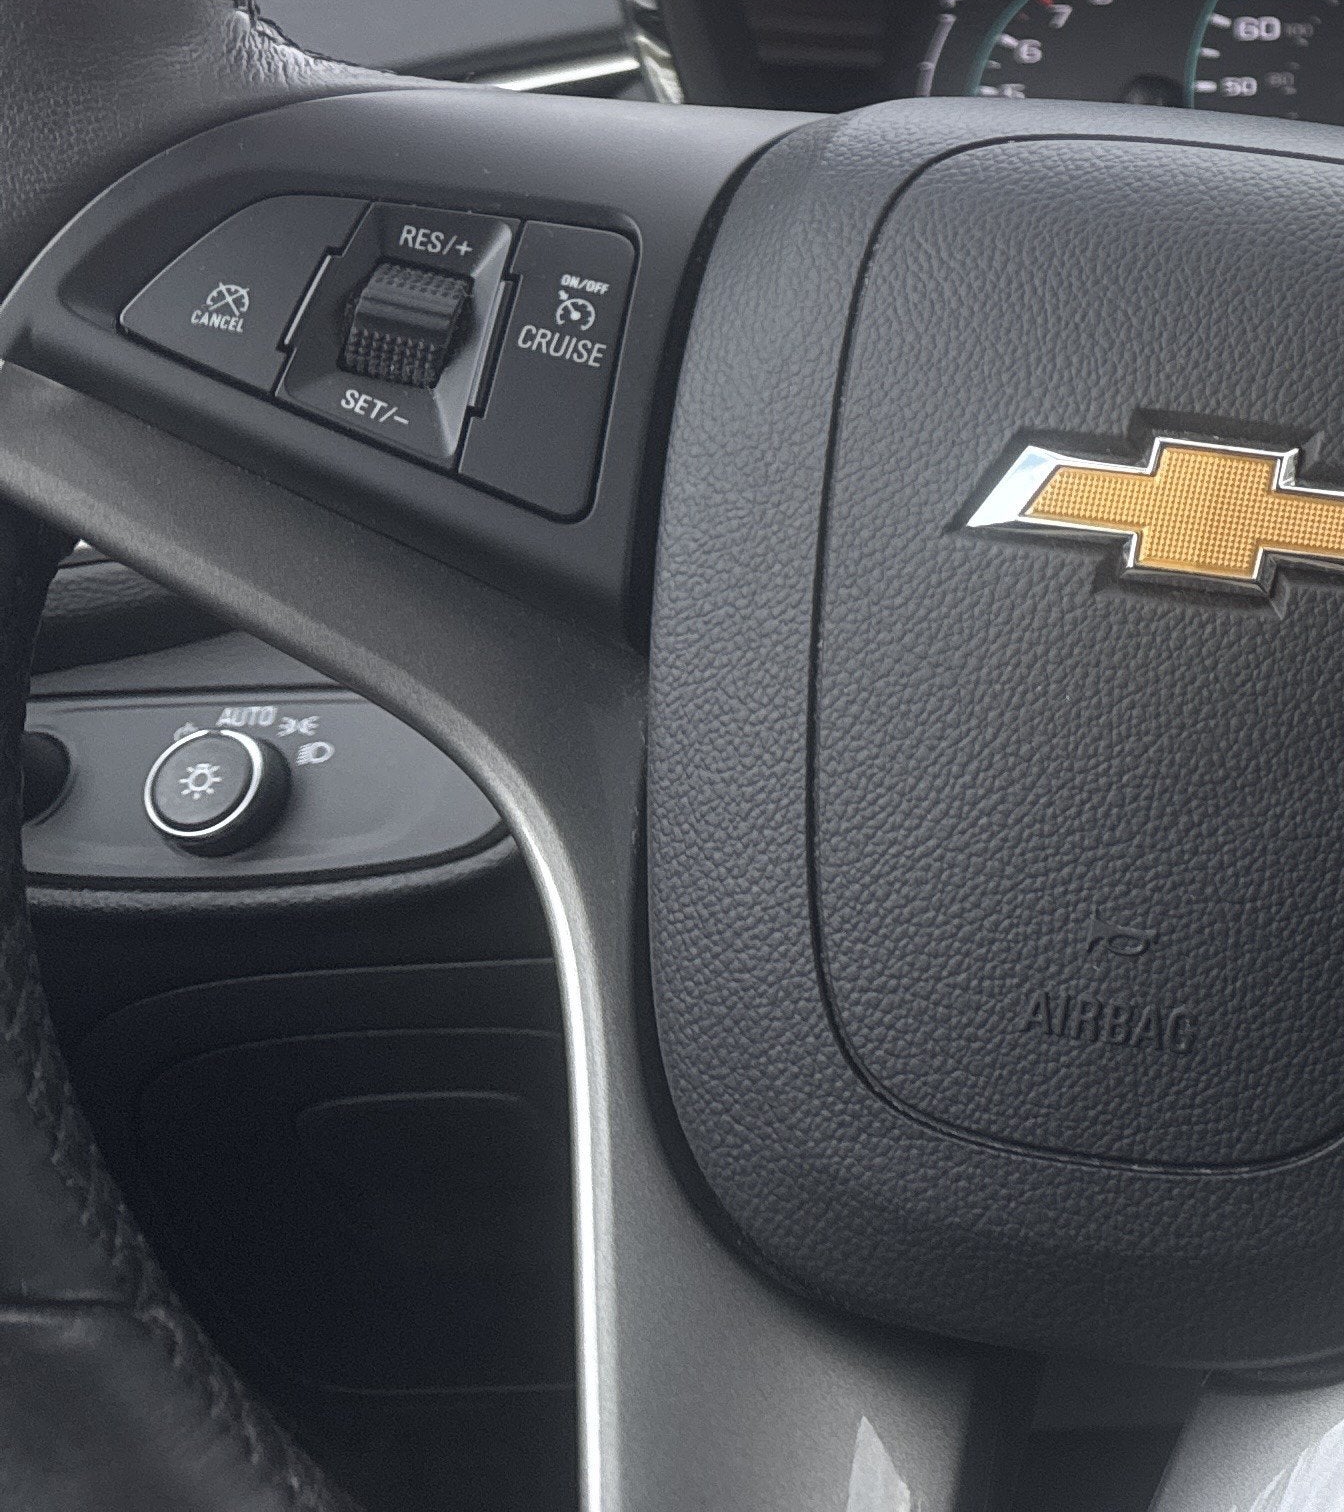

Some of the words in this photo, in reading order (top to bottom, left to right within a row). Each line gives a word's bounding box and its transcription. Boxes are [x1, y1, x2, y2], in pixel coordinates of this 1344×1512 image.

[1050, 4, 1073, 29] 7
[1233, 15, 1281, 42] 60
[1014, 39, 1043, 64] 6
[1221, 76, 1258, 97] 50
[560, 273, 610, 295] ON/OFF
[190, 309, 244, 334] CANCEL
[517, 324, 608, 368] CRUISE
[215, 705, 277, 727] AUTO
[1020, 990, 1200, 1055] AIRBAG
